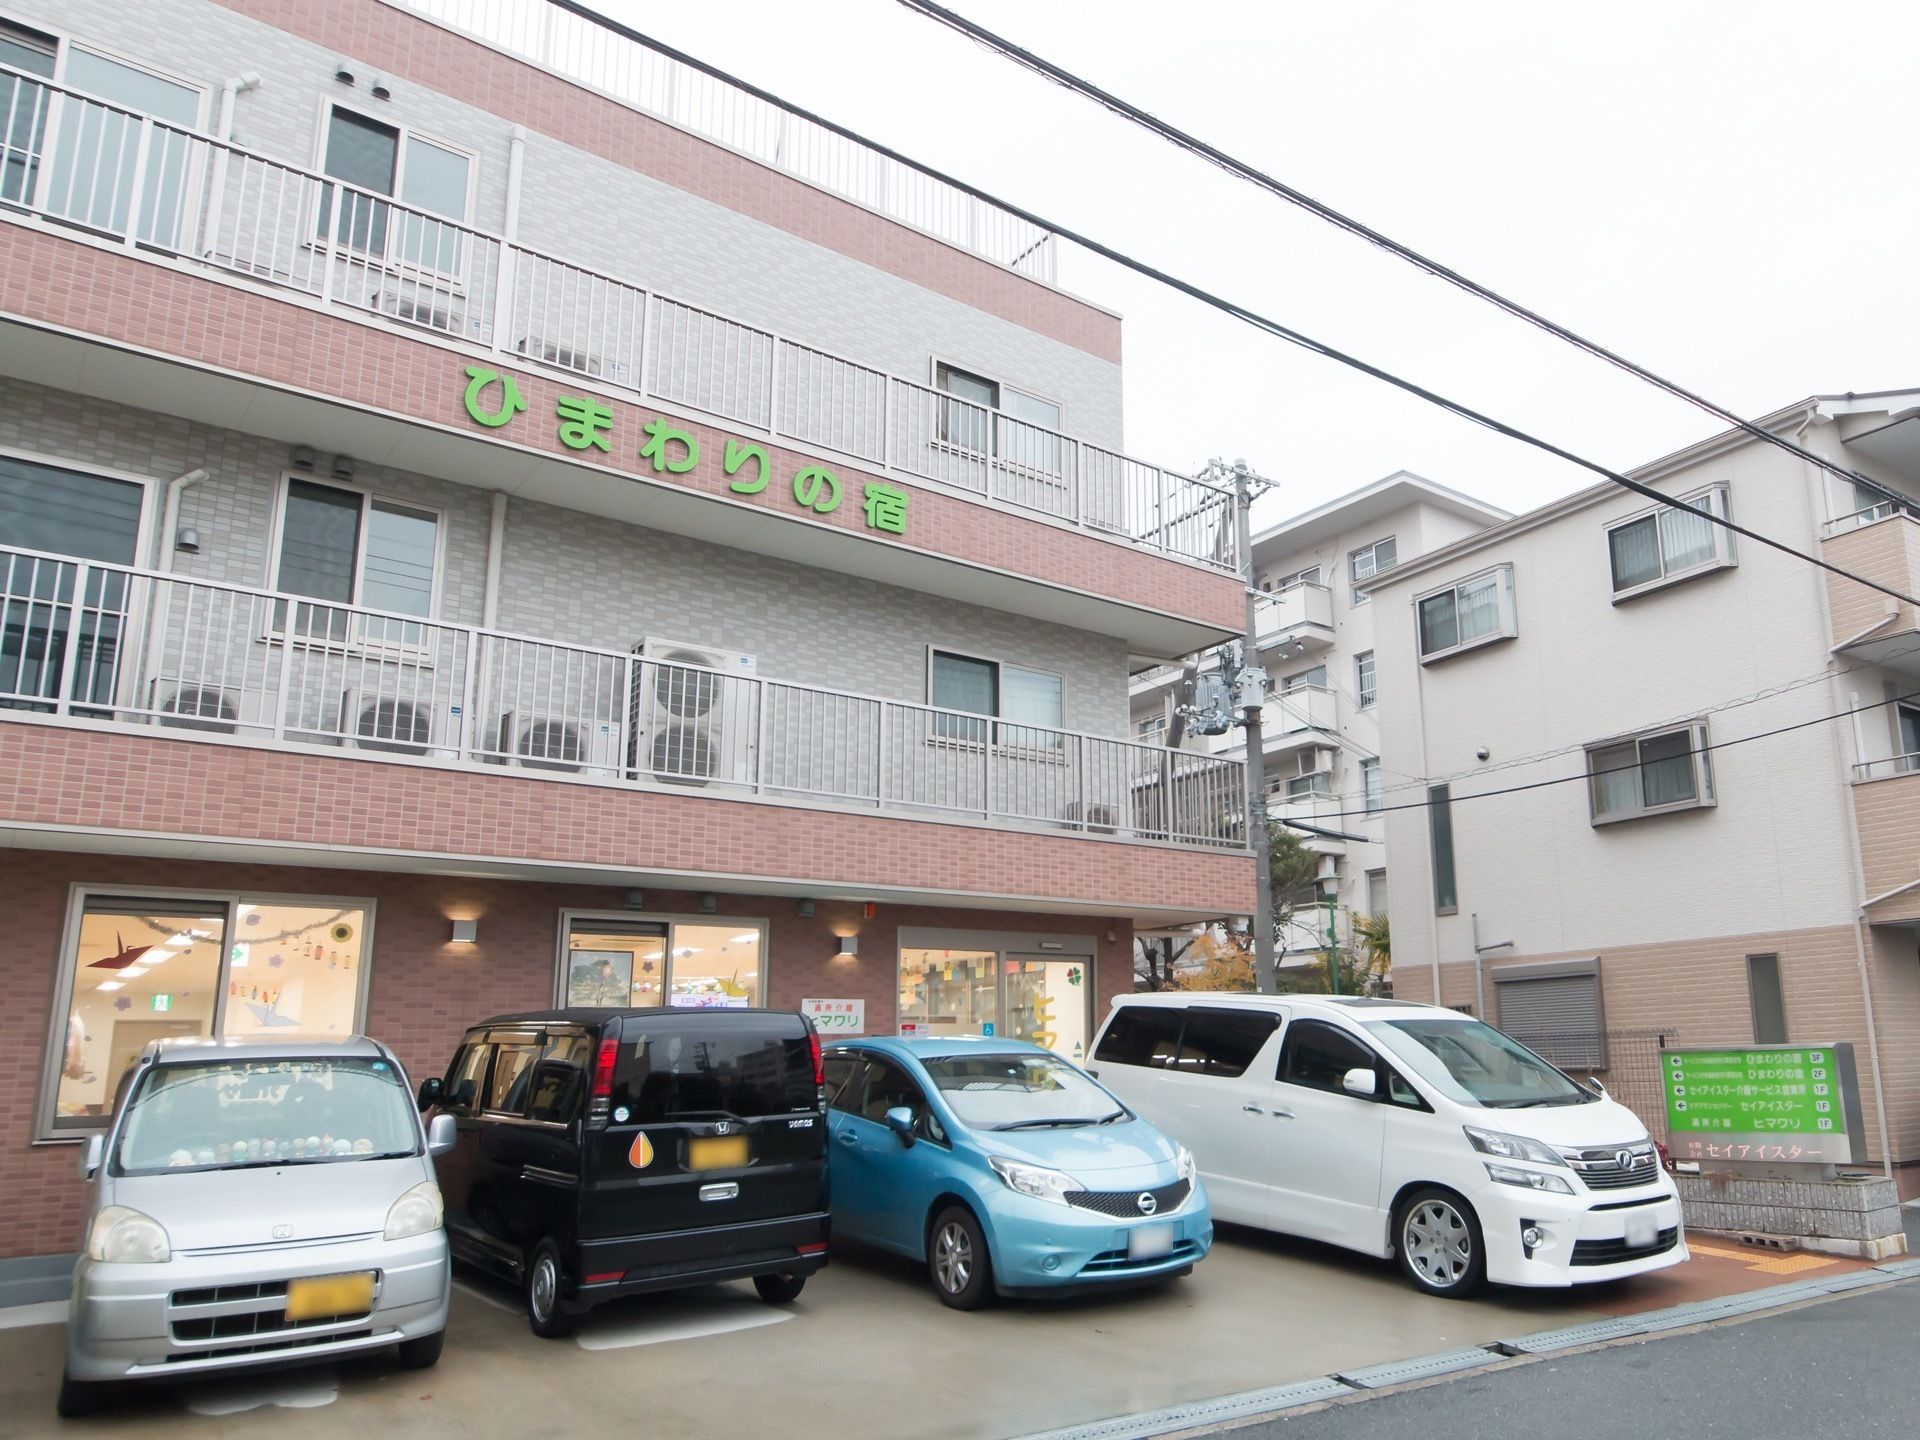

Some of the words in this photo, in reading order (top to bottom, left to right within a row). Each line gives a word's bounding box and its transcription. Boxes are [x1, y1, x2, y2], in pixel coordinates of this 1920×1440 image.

[465, 366, 909, 533] ひまわりの宿
[1811, 1053, 1821, 1062] 3F
[1813, 1070, 1823, 1078] 2F
[1815, 1085, 1826, 1094] 1F
[1740, 1101, 1802, 1112] セイアイスター
[1817, 1102, 1828, 1111] 1F
[1753, 1118, 1801, 1129] ヒマワリ
[1819, 1120, 1830, 1128] 1F
[1706, 1143, 1822, 1160] セイアイスター
